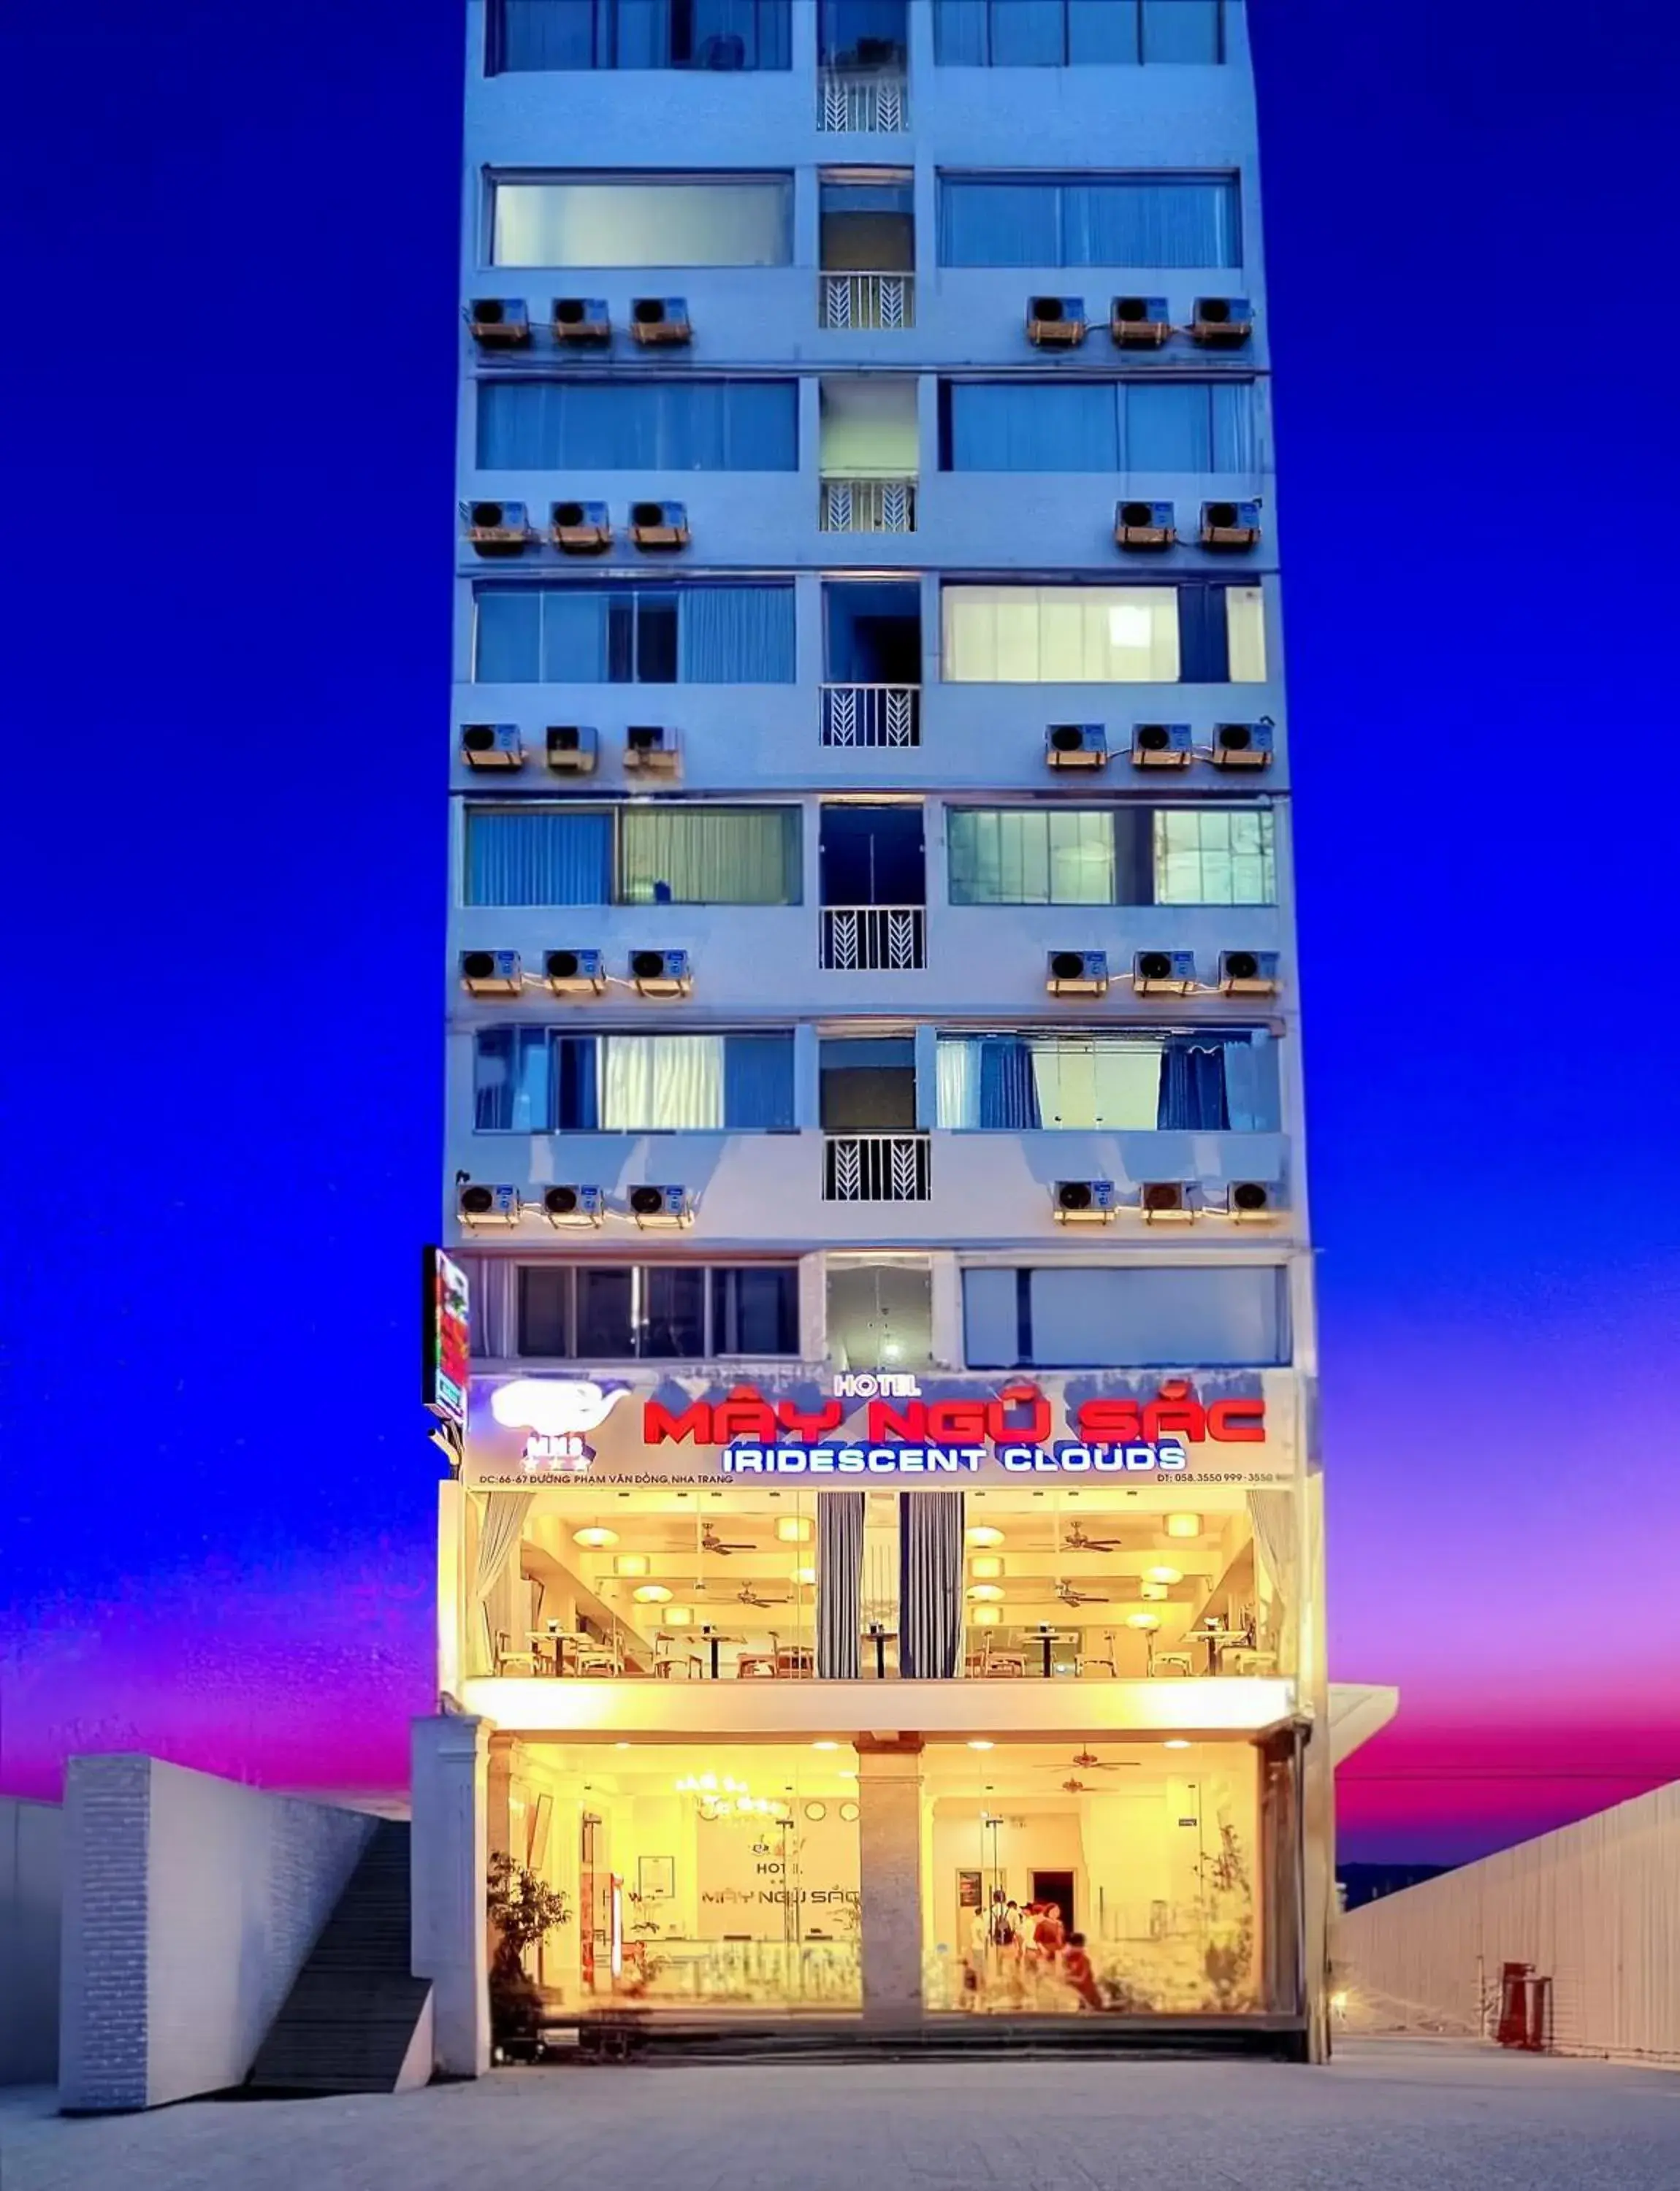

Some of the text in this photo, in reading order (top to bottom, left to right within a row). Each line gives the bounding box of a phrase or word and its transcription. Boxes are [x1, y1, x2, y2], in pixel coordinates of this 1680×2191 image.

[833, 1374, 922, 1397] HOTEL
[722, 1447, 1187, 1473] IRIDESCENT CLOUDS
[671, 1475, 695, 1484] NHA
[698, 1474, 734, 1484] TRANG
